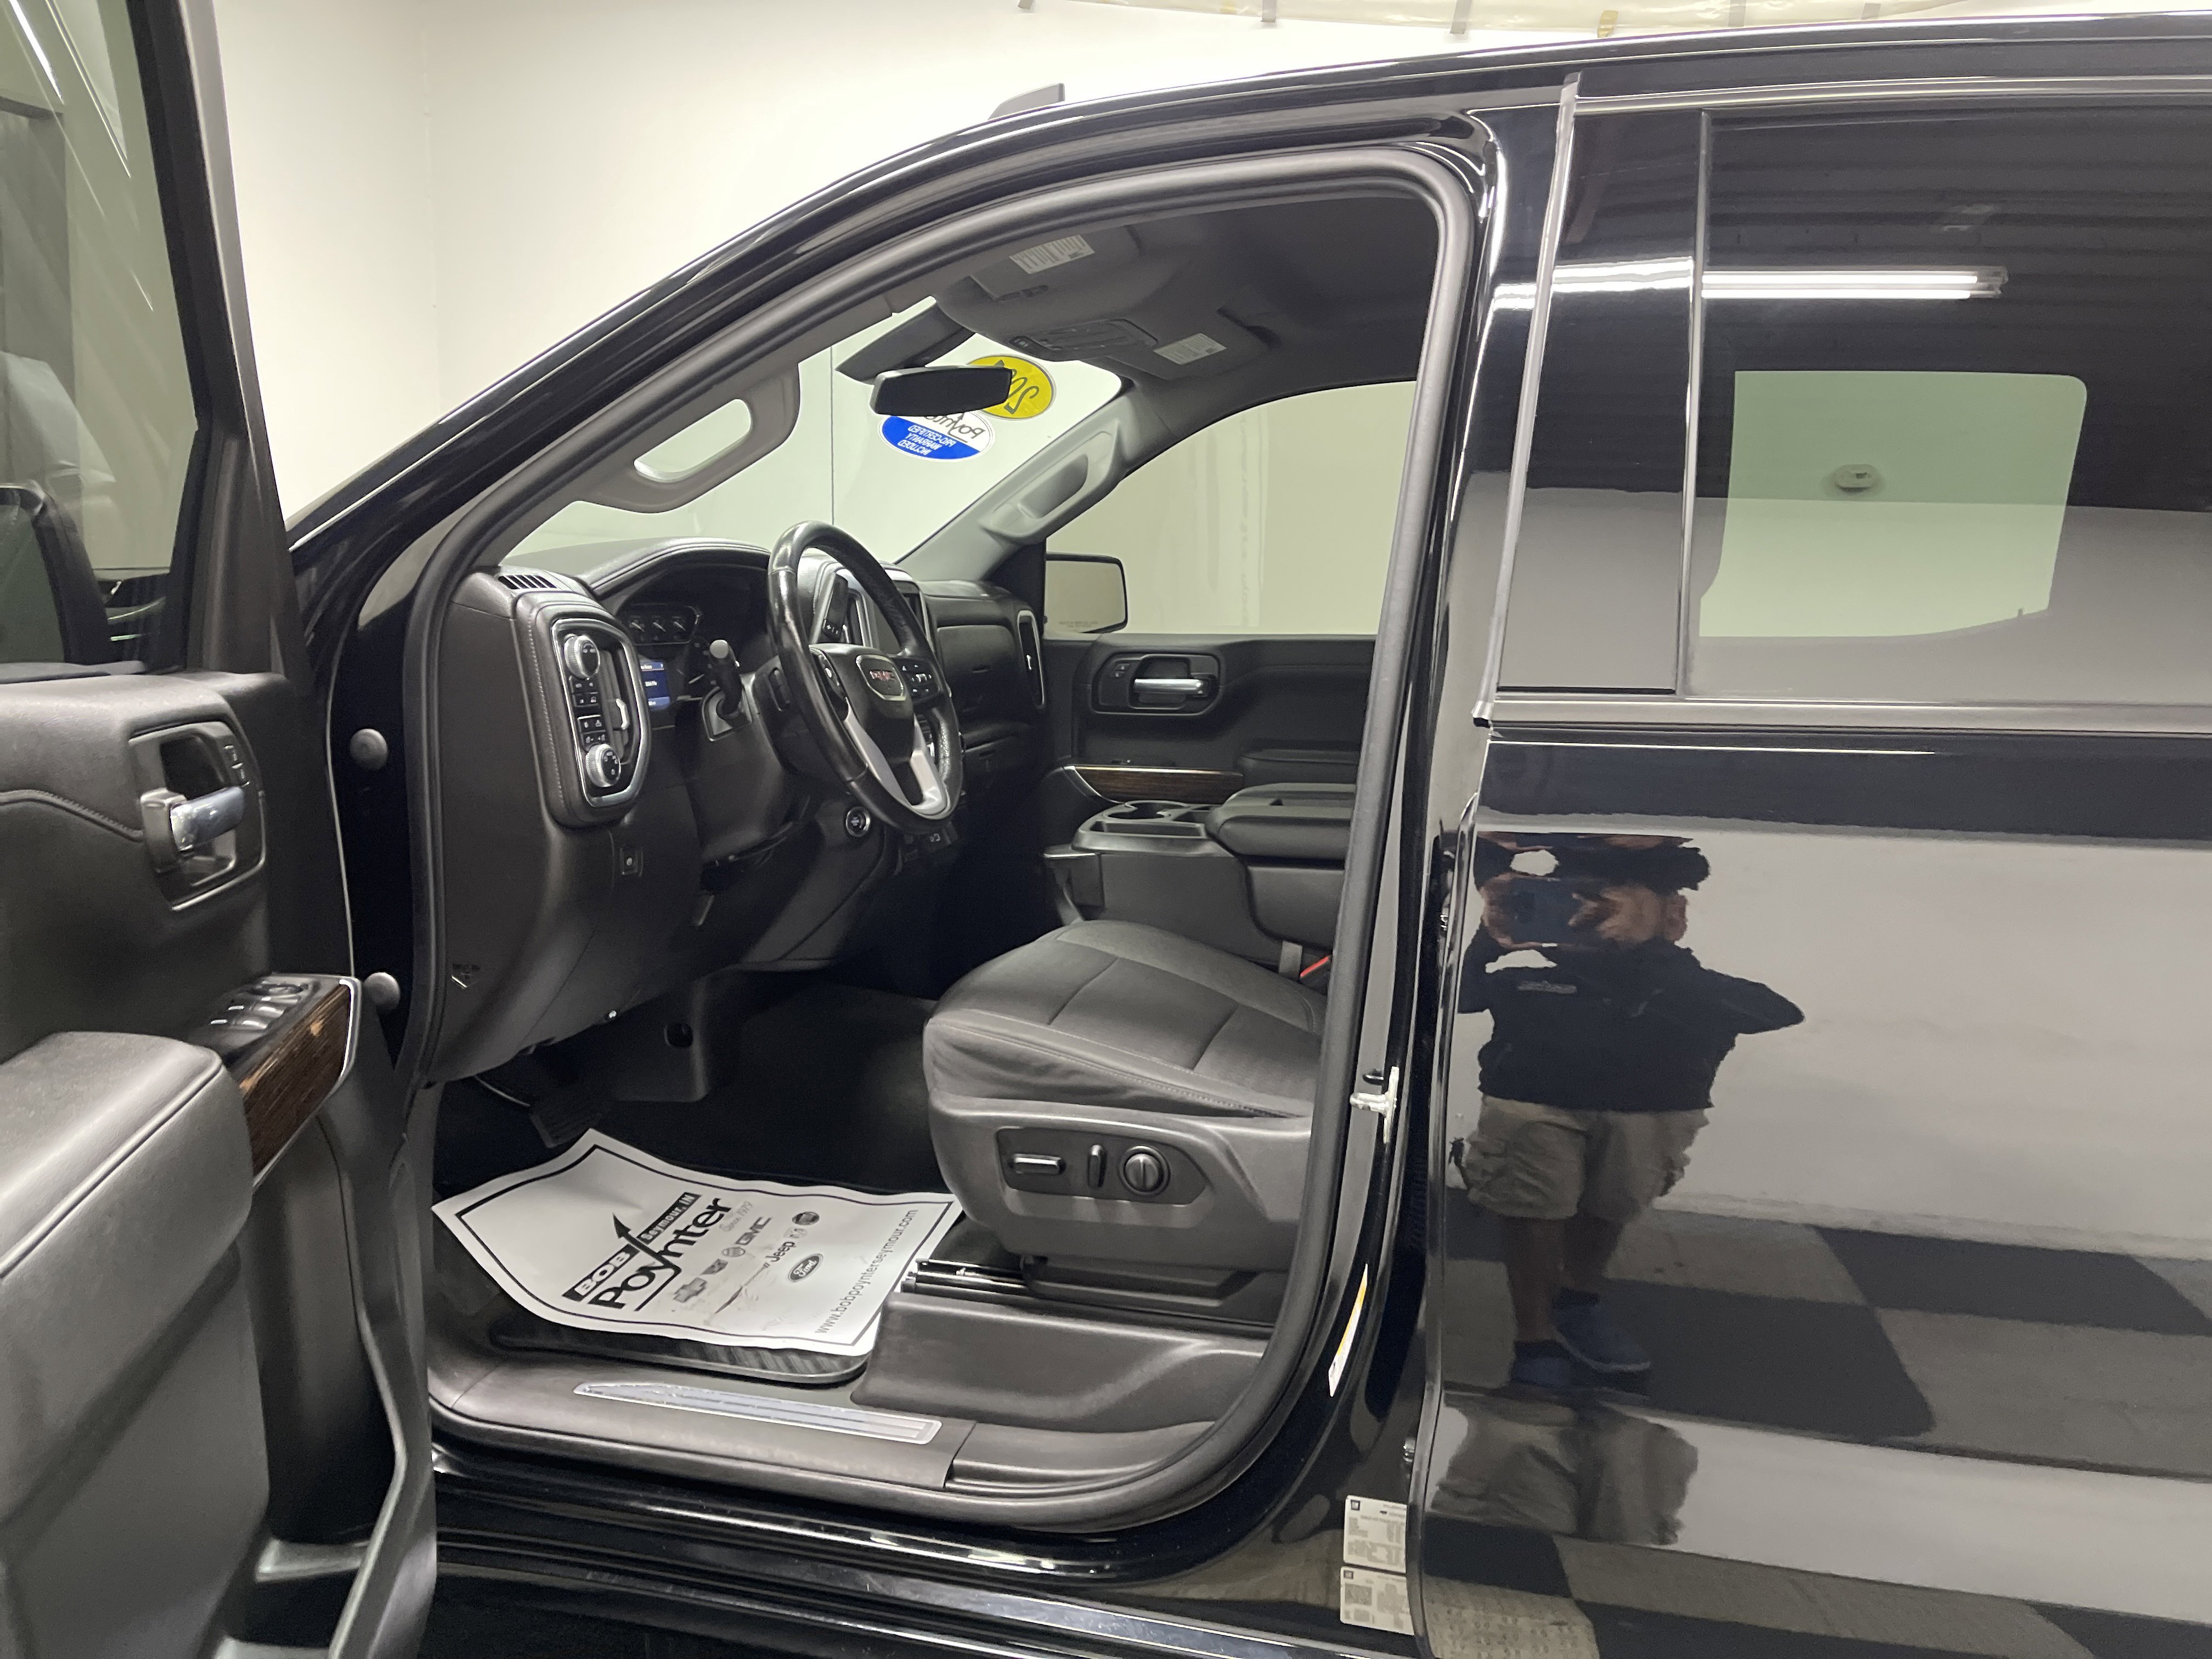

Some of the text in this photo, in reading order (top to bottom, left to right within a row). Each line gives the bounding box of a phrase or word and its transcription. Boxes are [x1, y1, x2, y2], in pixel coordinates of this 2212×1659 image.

[735, 1216, 772, 1245] GMC
[765, 1241, 797, 1262] Jeep
[574, 1251, 630, 1296] BOB
[587, 1198, 731, 1312] Poynter
[815, 1210, 918, 1333] www.bobpoynterseymour.com
